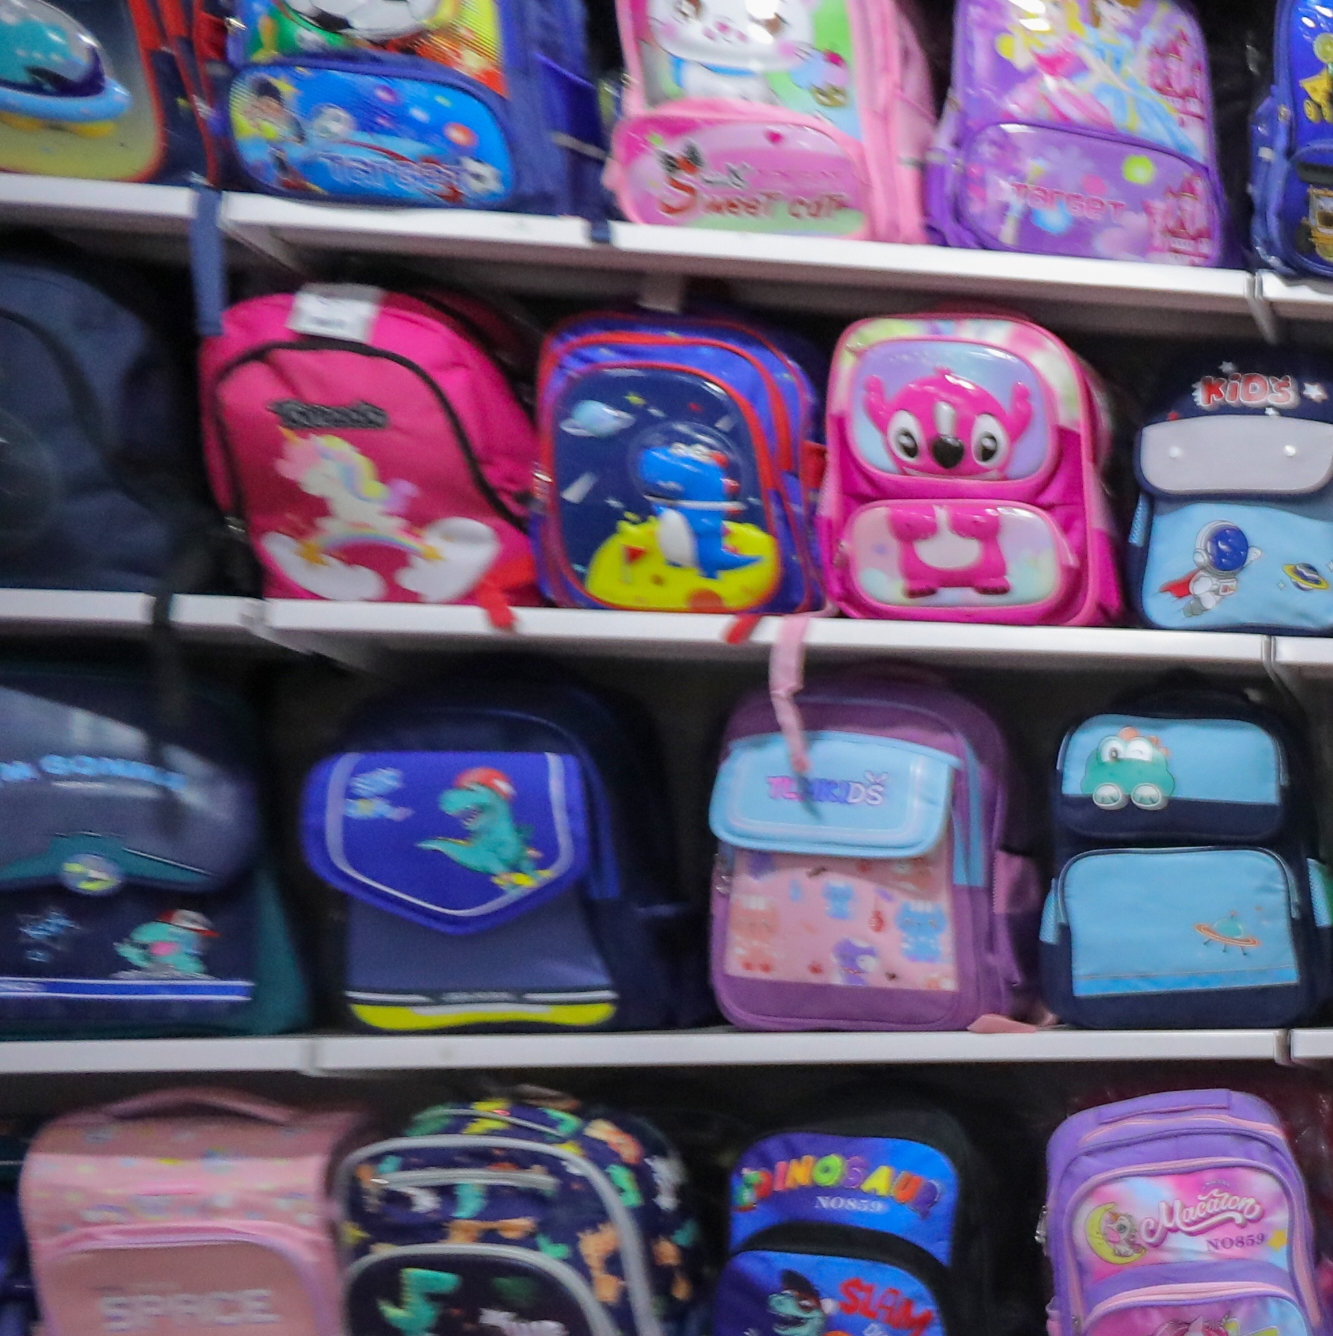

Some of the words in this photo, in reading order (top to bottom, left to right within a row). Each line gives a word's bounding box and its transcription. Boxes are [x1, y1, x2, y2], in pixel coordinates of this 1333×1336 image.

[732, 1153, 942, 1220] DINOSAUR
[1140, 1188, 1265, 1246] Macaron
[101, 1288, 281, 1334] SPACE
